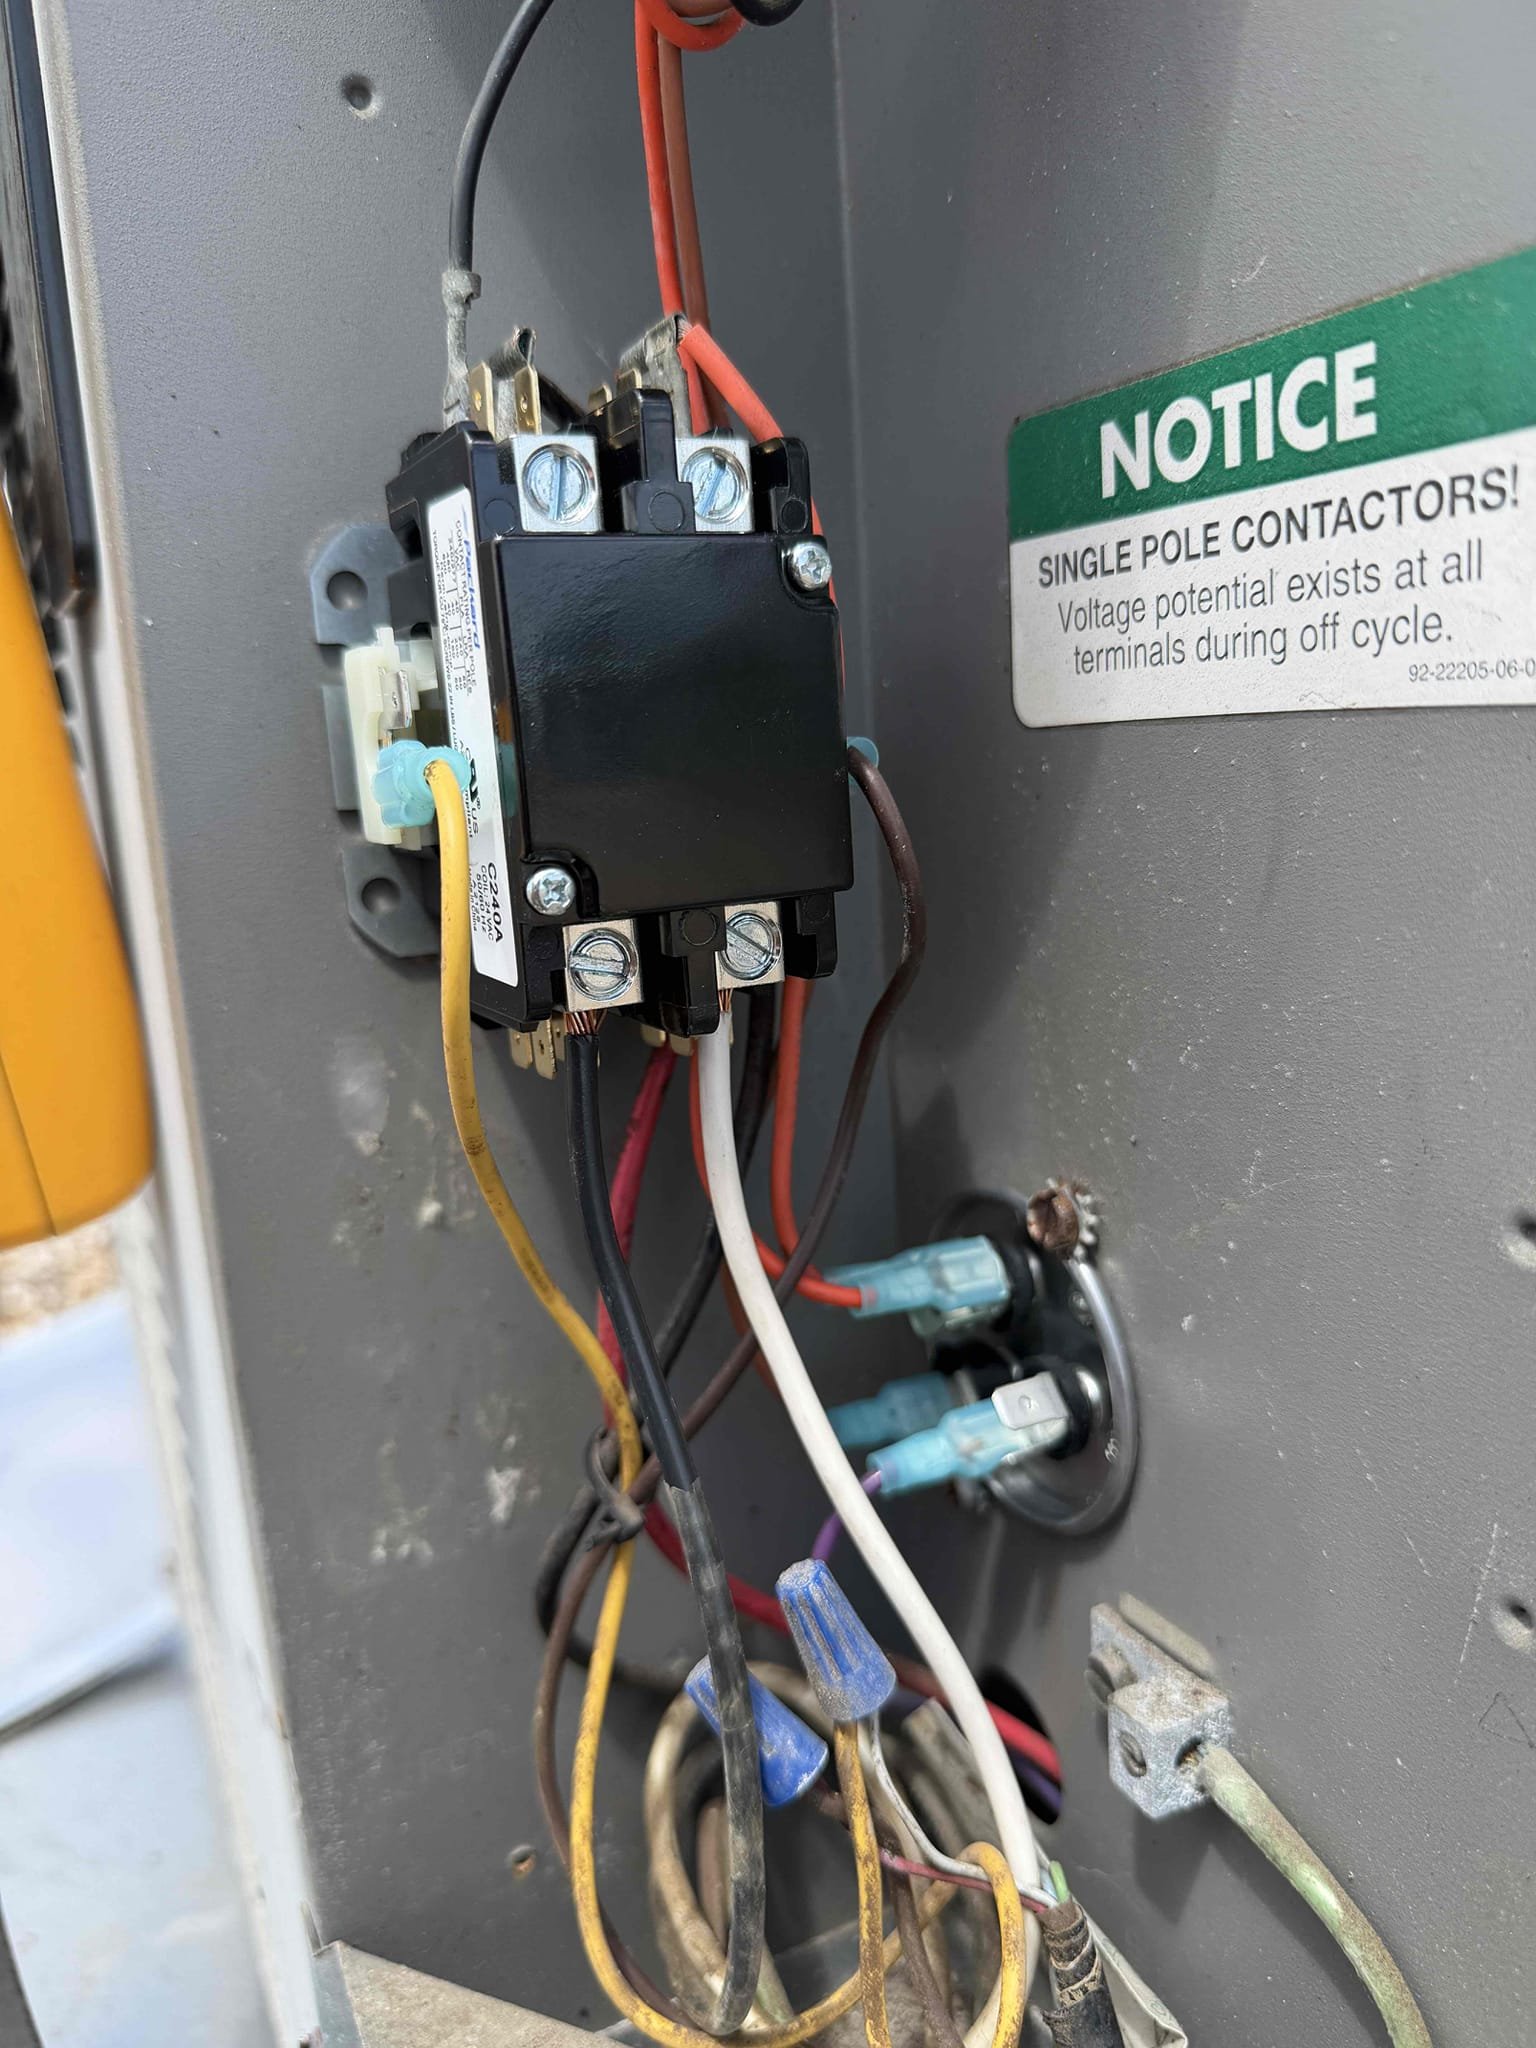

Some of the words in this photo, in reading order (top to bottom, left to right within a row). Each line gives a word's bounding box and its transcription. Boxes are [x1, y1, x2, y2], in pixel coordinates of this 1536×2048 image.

[1100, 340, 1378, 500] NOTICE
[1038, 538, 1132, 588] SINGLE
[1142, 521, 1221, 570] POLE
[1231, 464, 1519, 553] CONTACTORS!
[455, 518, 466, 577] CONTACT
[461, 580, 470, 625] RATING
[468, 654, 476, 687] POLE
[463, 538, 480, 649] Packard
[1057, 596, 1146, 636] Voltage
[1155, 569, 1275, 628] potential
[1286, 559, 1381, 603] exists
[1394, 549, 1428, 589] at
[1441, 537, 1483, 583] all
[1074, 635, 1186, 675] terminals
[1195, 619, 1287, 666] during
[1299, 613, 1341, 653] off
[1351, 603, 1453, 656] cycle.
[464, 790, 472, 837] mpliant
[476, 873, 484, 911] 50/60
[480, 864, 489, 898] COIL:
[484, 900, 491, 915] 24
[487, 861, 503, 944] C240A
[485, 916, 494, 941] VAC
